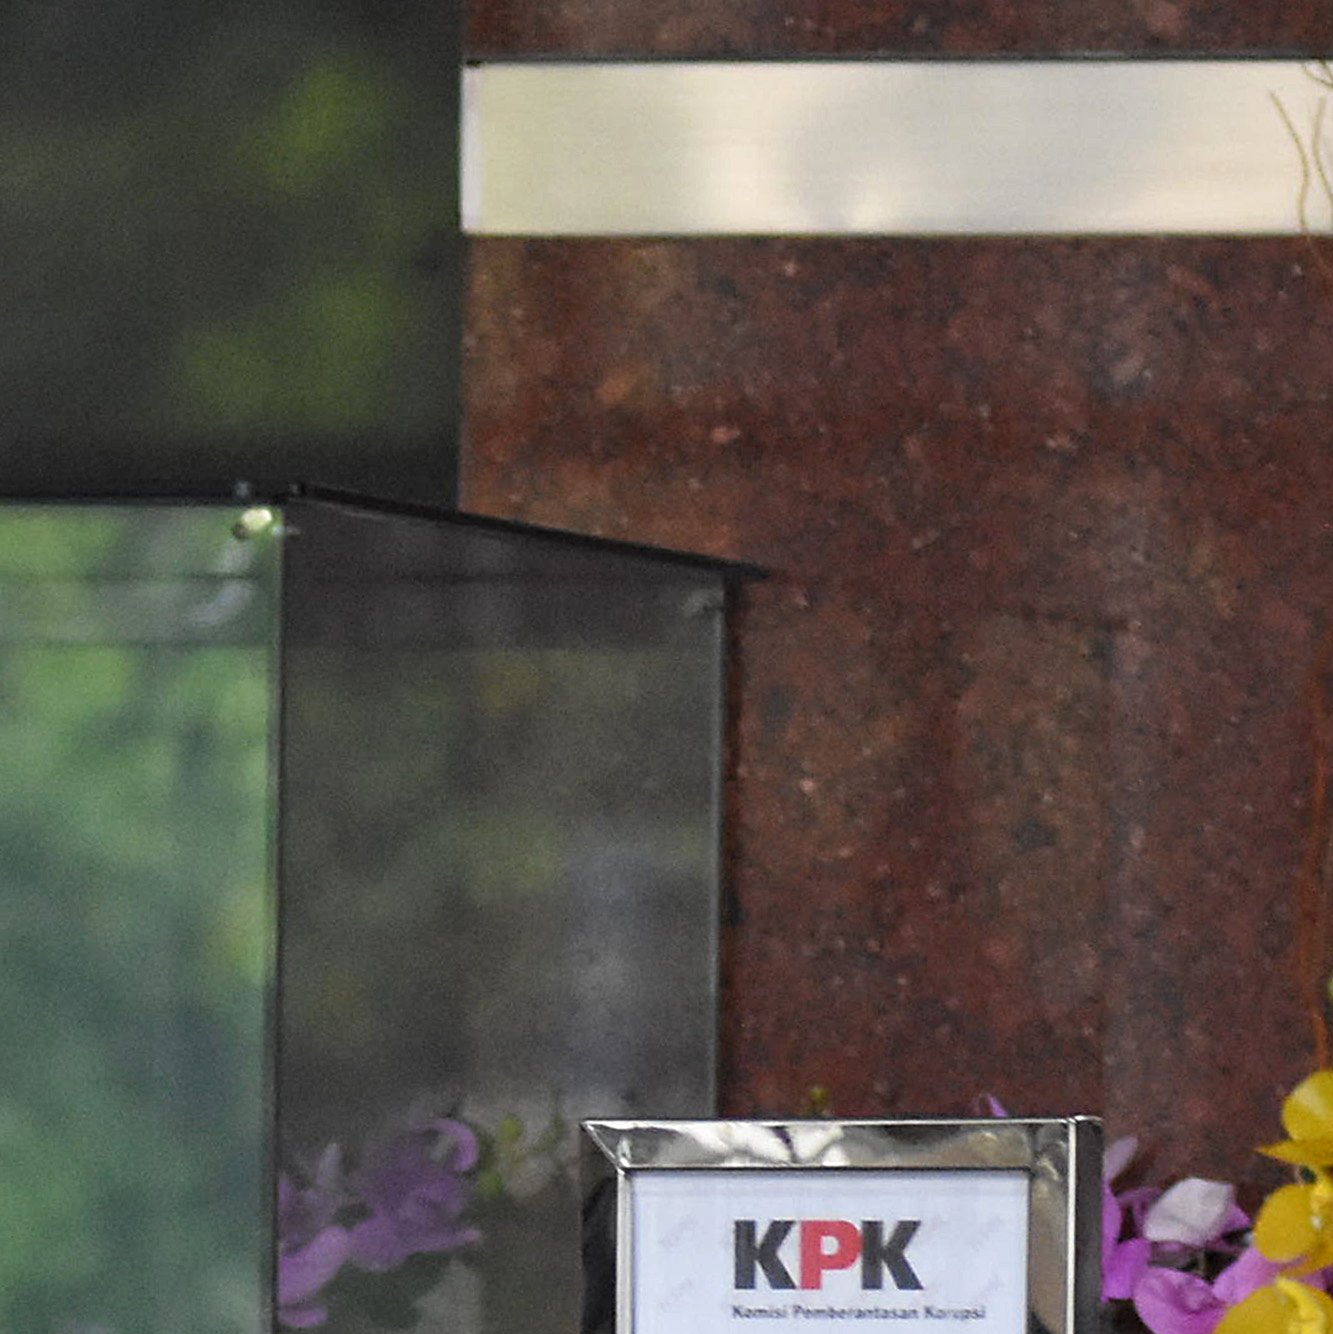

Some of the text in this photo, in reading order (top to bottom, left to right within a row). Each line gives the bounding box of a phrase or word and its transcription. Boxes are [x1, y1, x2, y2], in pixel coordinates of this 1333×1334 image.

[733, 1219, 925, 1291] KPK
[732, 1304, 986, 1322] Komisi Pemberantasan Korupsi
